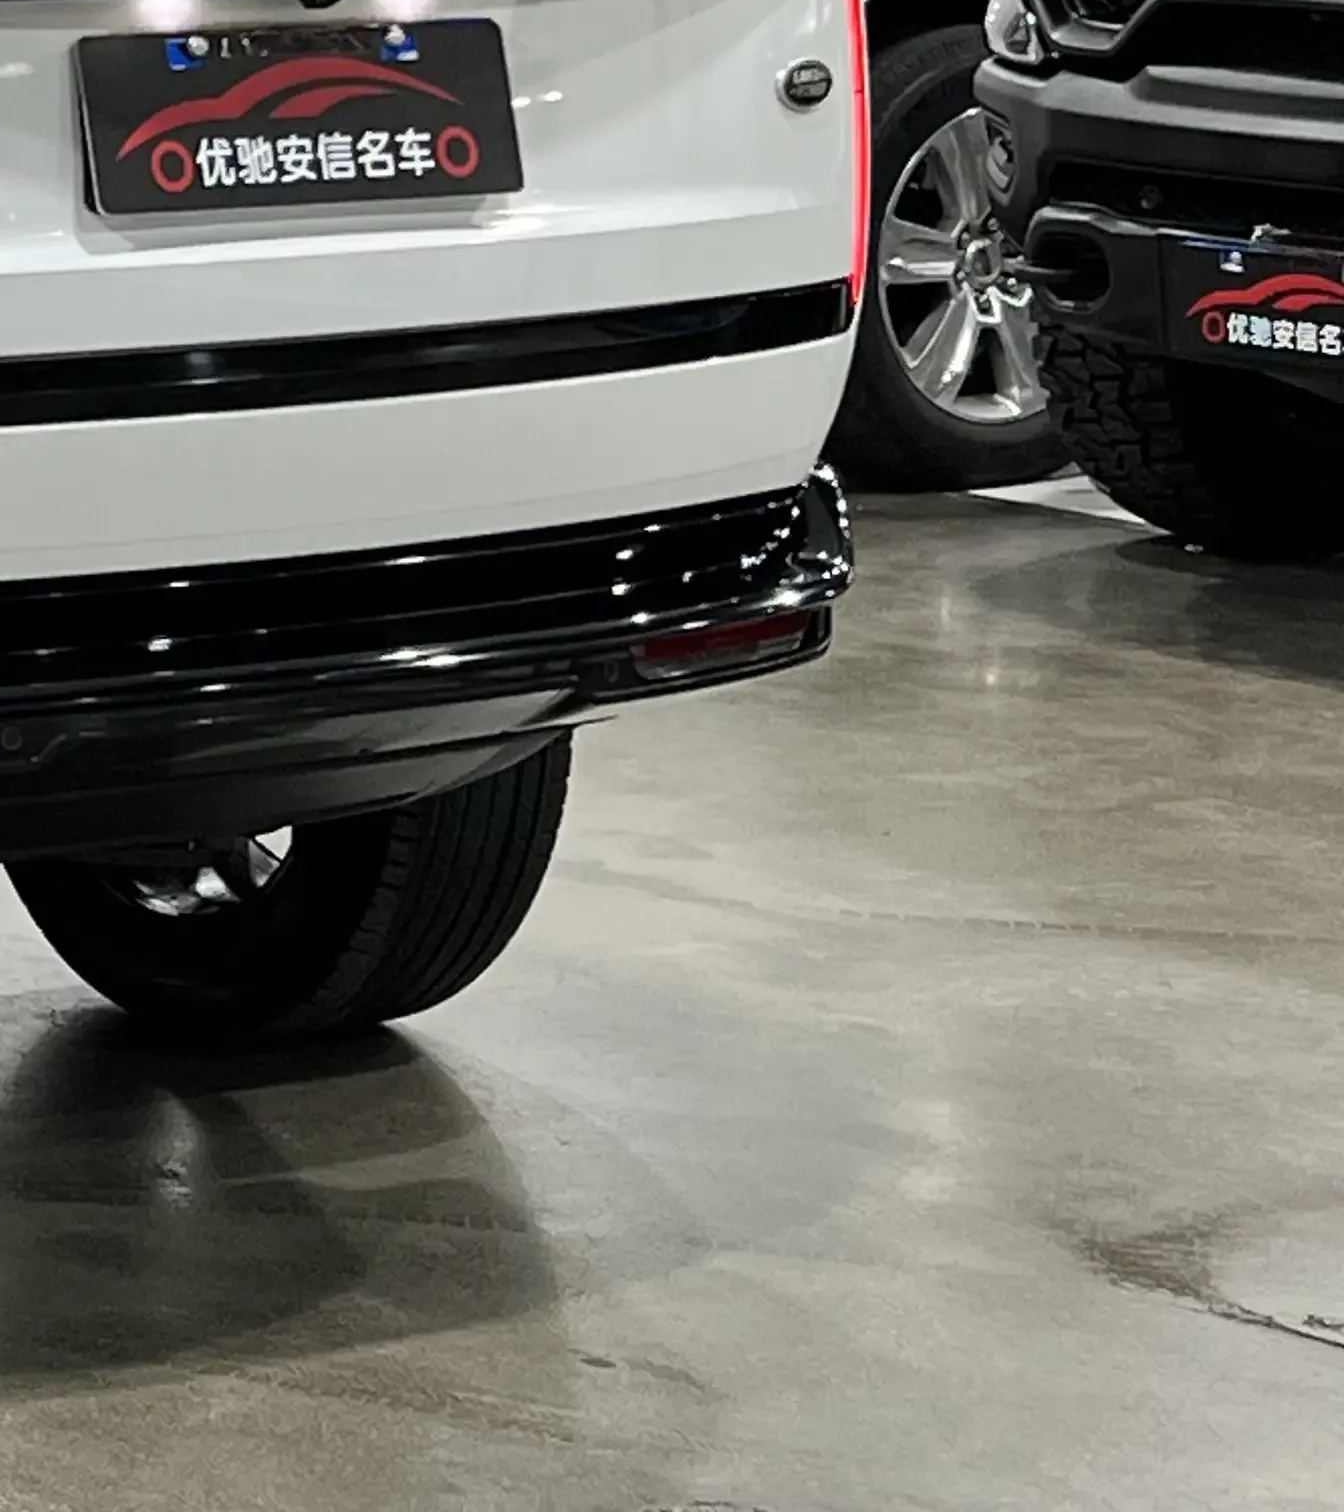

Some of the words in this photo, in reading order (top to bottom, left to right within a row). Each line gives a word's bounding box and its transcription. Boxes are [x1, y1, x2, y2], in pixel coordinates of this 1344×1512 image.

[195, 126, 437, 189] 优驰安信名车
[1226, 311, 1344, 356] 优驰安信名
